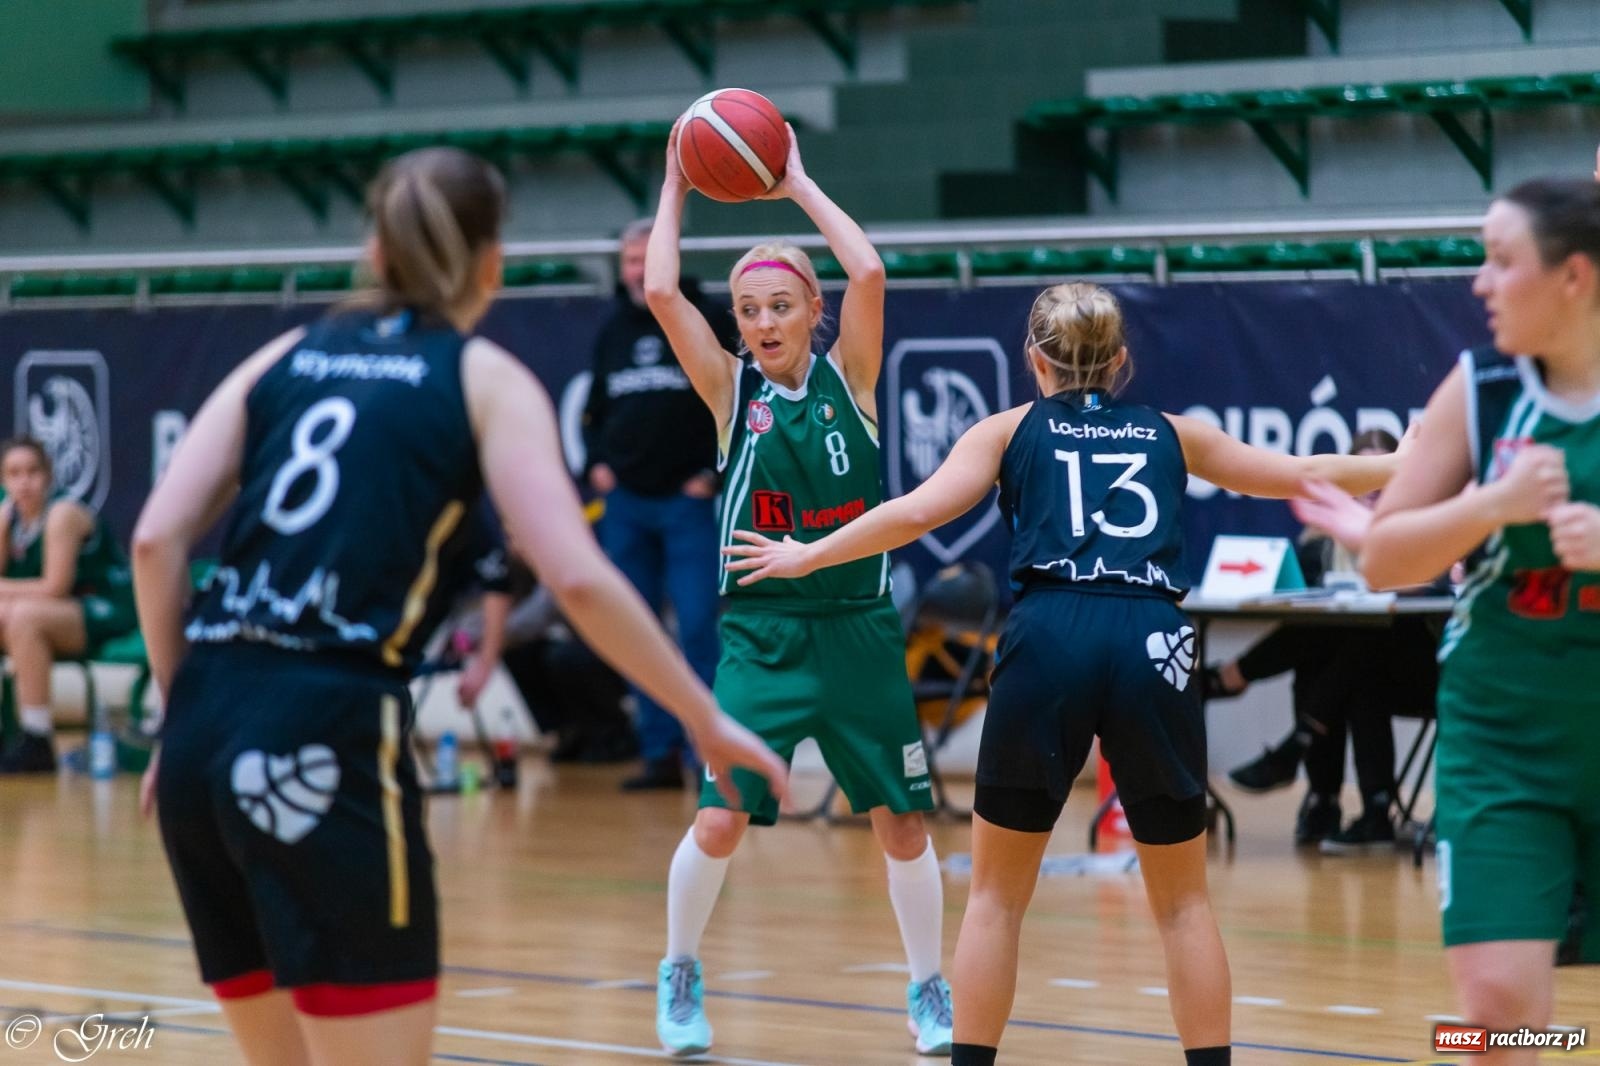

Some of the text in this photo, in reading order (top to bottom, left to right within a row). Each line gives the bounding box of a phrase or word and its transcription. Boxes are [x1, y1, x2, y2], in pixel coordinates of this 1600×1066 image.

[1048, 418, 1158, 441] Lachowicz
[261, 396, 356, 535] 8
[825, 430, 850, 476] 8
[757, 494, 789, 527] K
[1054, 448, 1159, 538] 13
